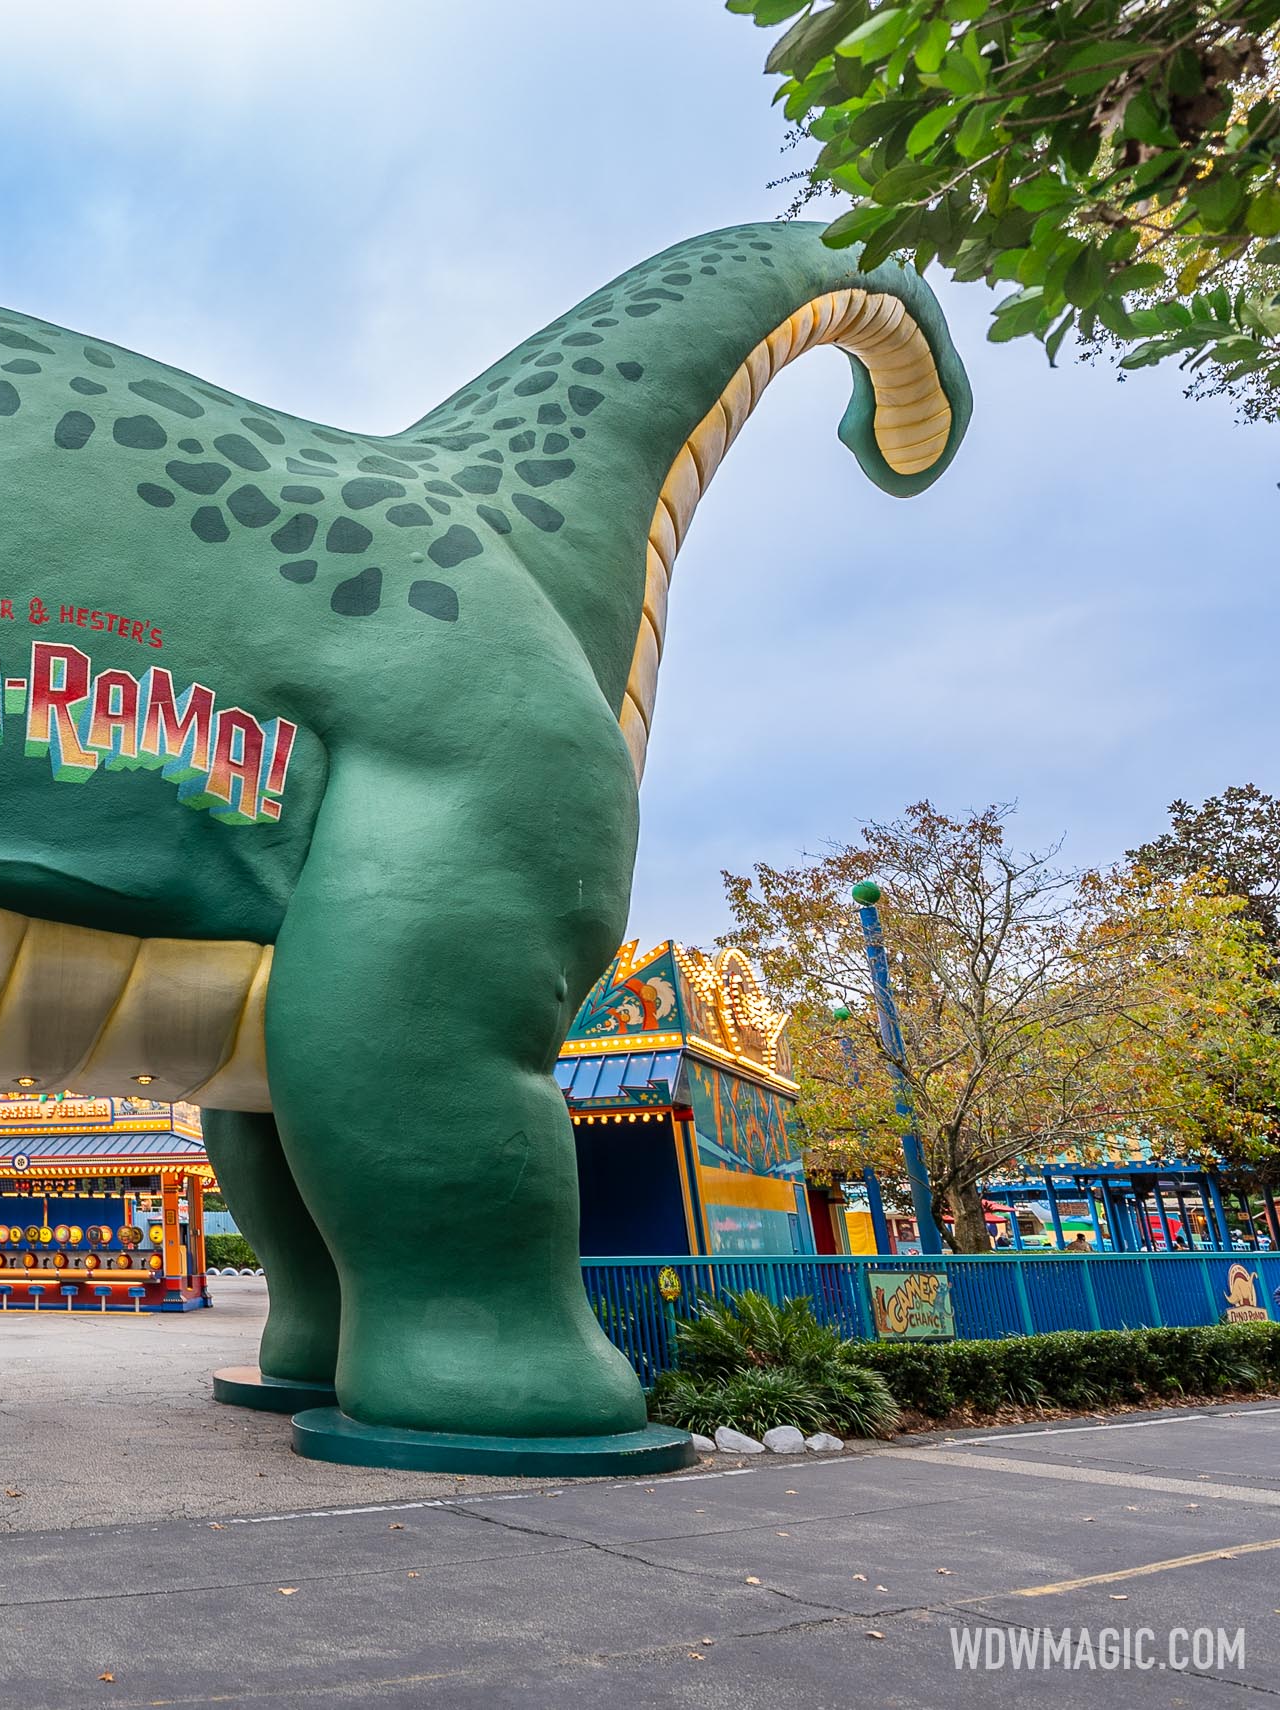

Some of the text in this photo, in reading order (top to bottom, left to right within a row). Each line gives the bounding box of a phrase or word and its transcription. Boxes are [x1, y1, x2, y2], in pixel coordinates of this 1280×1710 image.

[28, 597, 50, 625] &
[59, 605, 163, 648] HESTER'S
[47, 1103, 109, 1119] FUELER
[887, 1273, 939, 1334] GAMES
